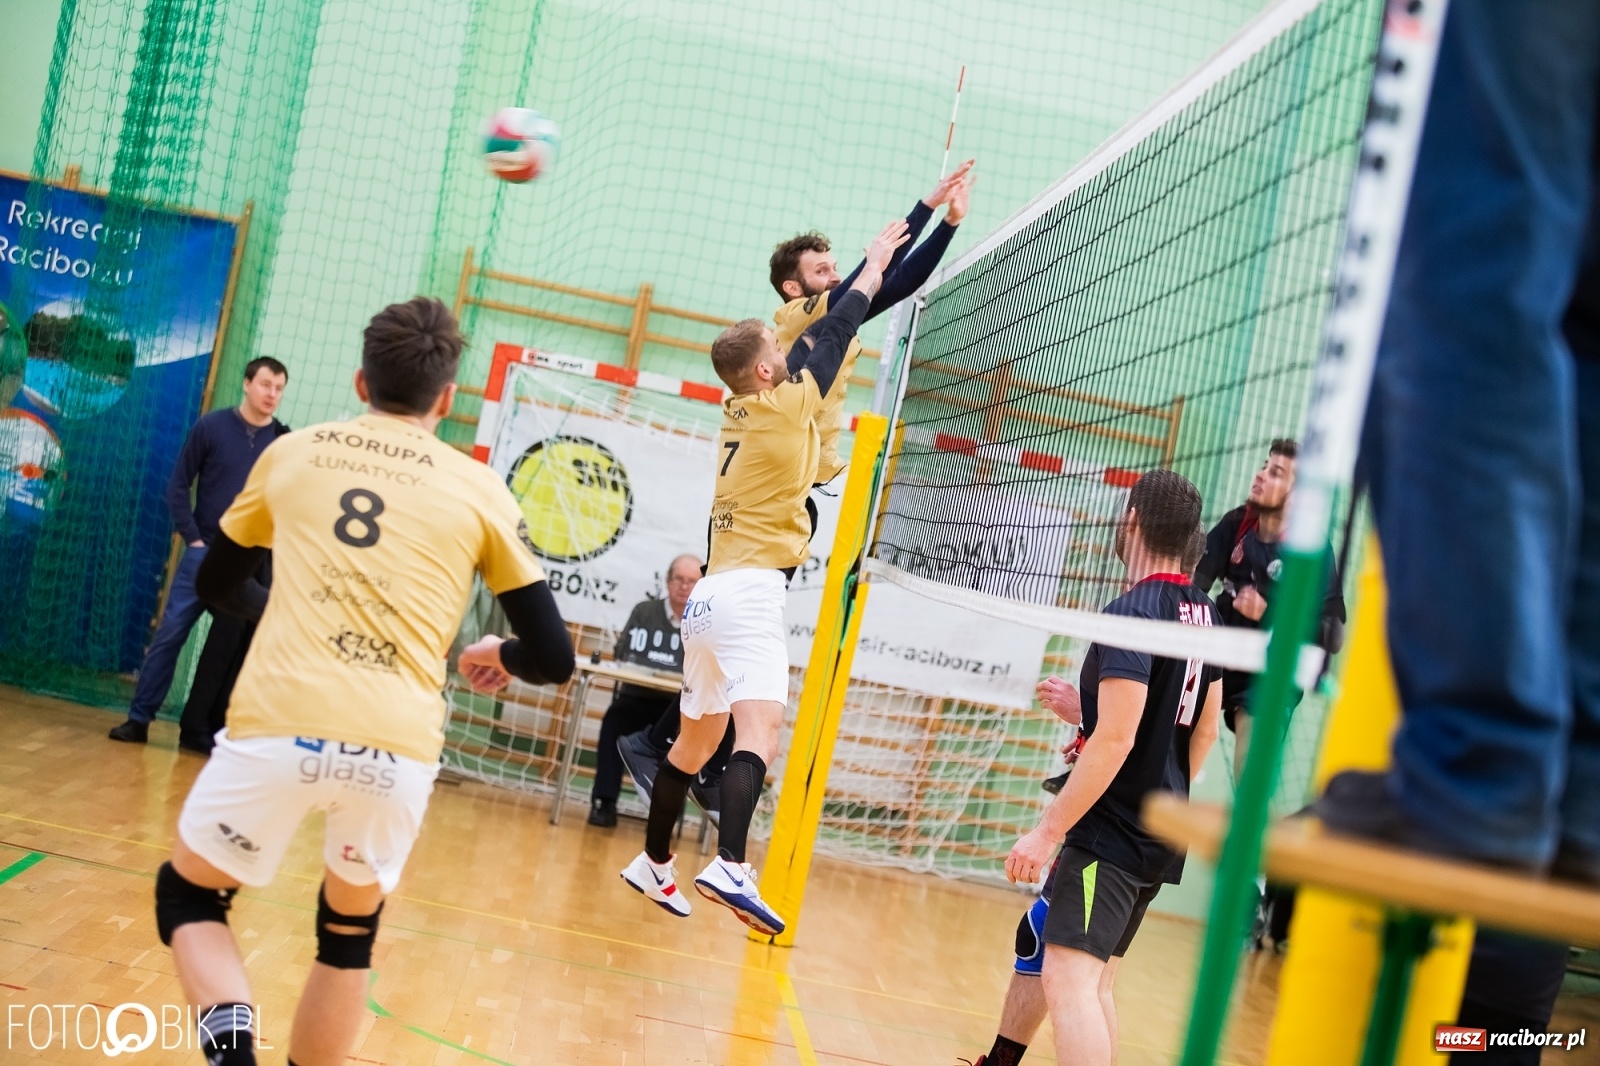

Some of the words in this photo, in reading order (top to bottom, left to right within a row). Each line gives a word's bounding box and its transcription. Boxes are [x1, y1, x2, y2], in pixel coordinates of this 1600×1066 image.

[8, 200, 142, 254] Rekreaji
[312, 430, 435, 467] SKORUPA
[720, 441, 740, 477] 7
[334, 488, 385, 548] 8
[629, 626, 649, 653] 10
[681, 614, 713, 641] glass
[299, 751, 398, 790] glass
